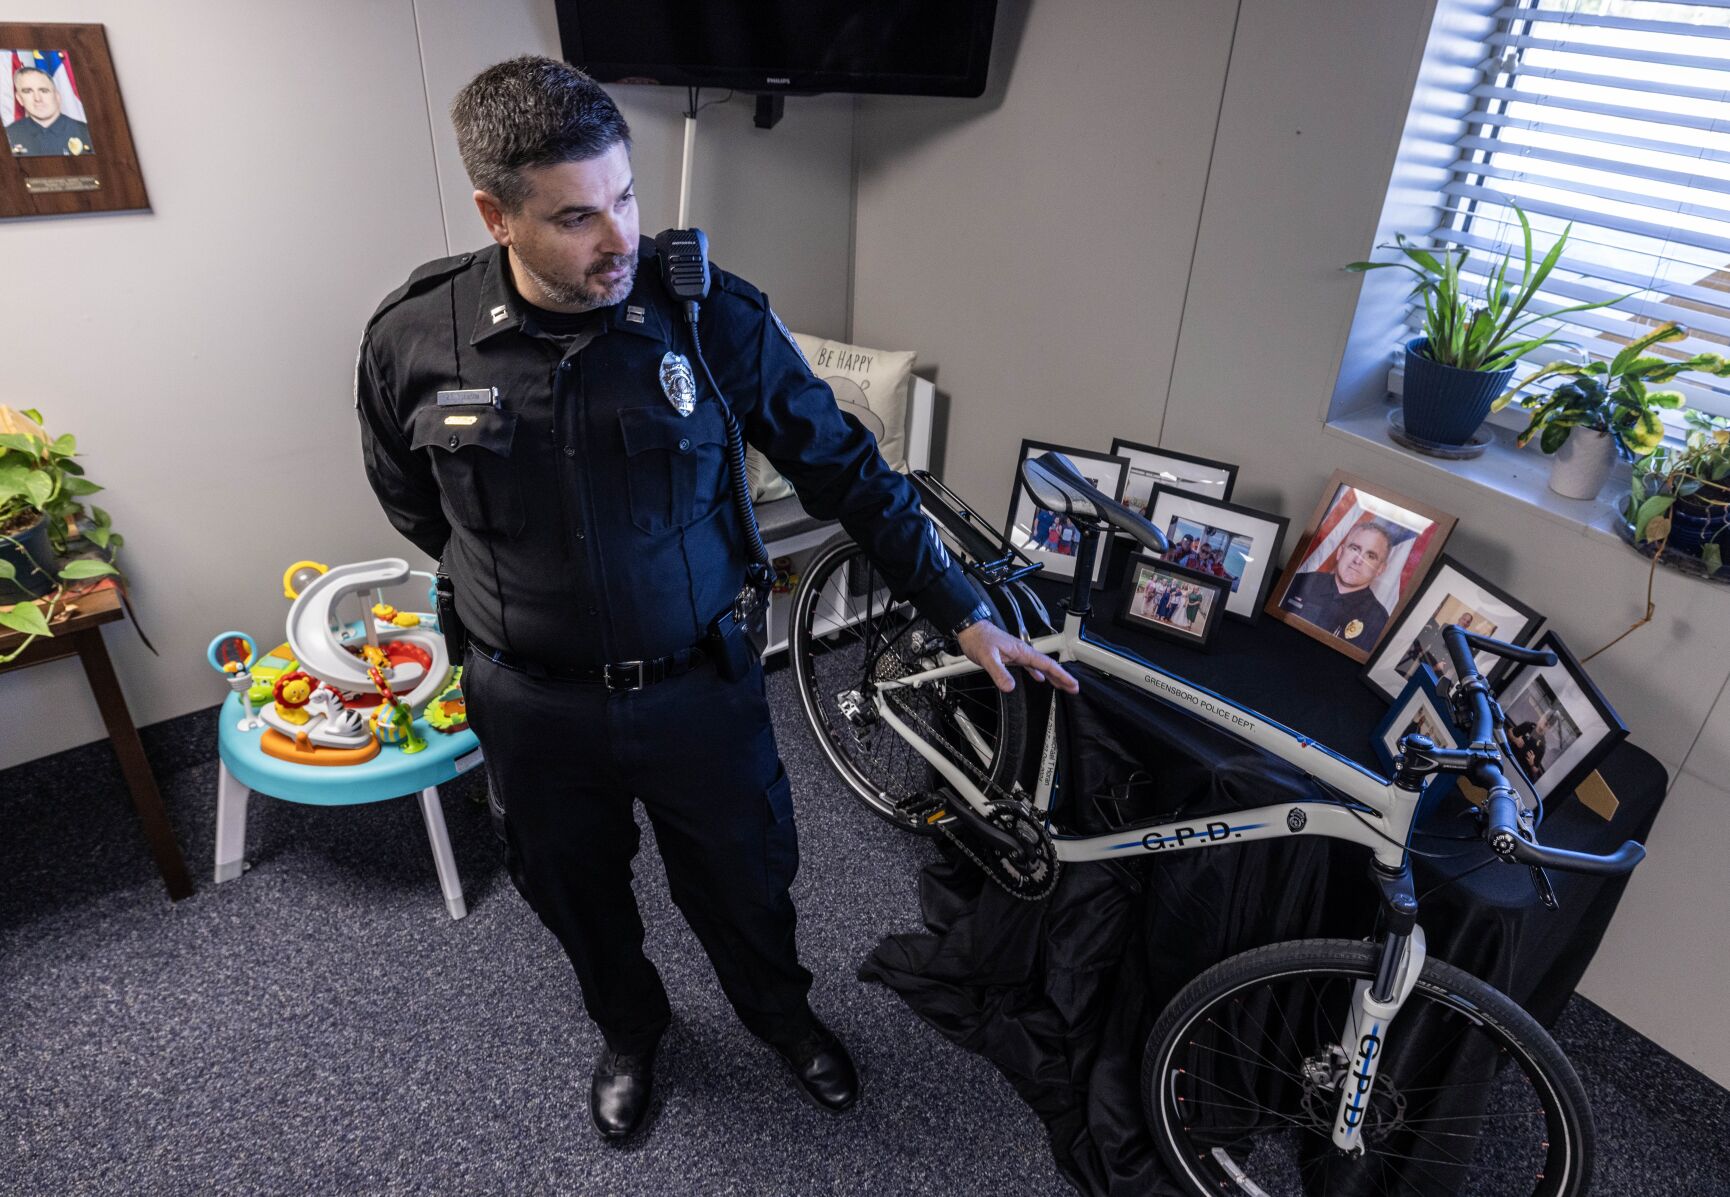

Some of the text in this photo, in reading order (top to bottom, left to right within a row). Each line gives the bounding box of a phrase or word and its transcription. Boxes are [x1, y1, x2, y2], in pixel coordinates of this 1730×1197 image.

[817, 347, 874, 373] BE HAPPY
[1144, 674, 1257, 734] GREENSBORO POLICE DEPT.
[1142, 821, 1242, 851] G.P.D.
[1340, 1034, 1381, 1134] G.P.D.
